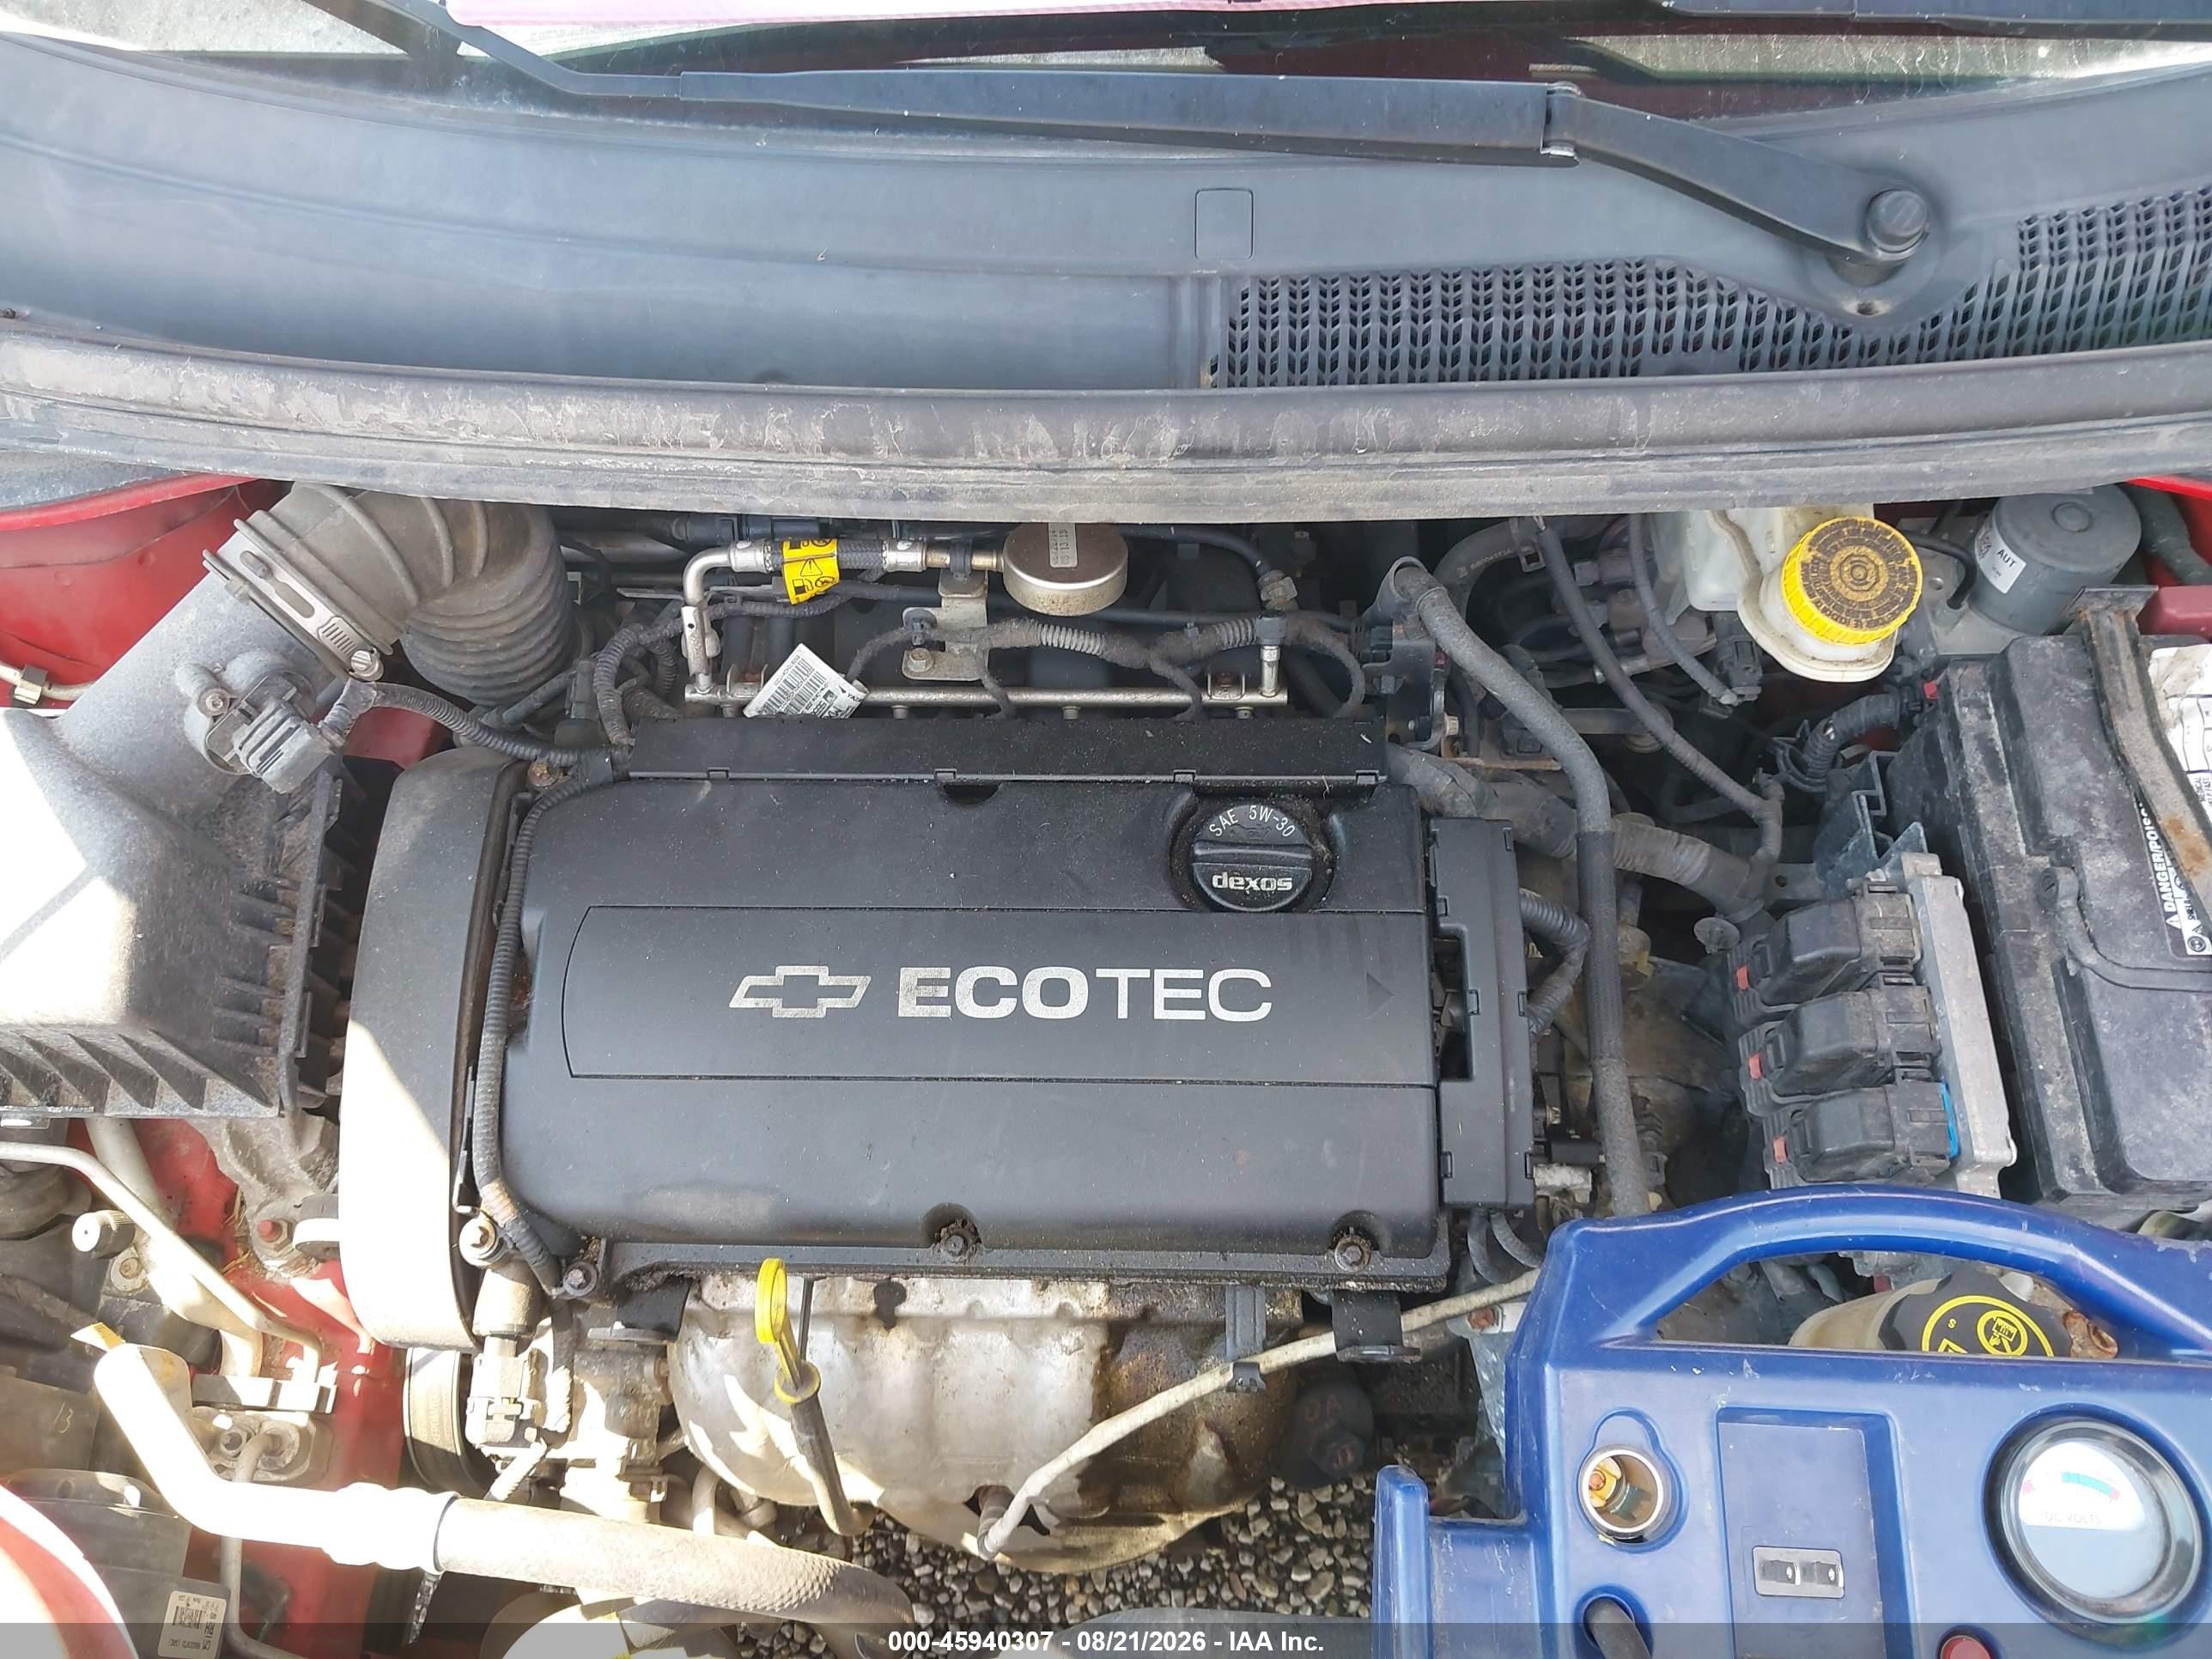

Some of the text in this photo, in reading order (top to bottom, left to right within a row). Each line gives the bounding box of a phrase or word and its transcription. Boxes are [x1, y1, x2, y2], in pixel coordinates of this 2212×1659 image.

[1208, 804, 1296, 838] SAE 5W-30
[1212, 872, 1293, 891] dexos
[898, 966, 1272, 1022] ECOTEC
[2067, 1512, 2102, 1524] VOLTS
